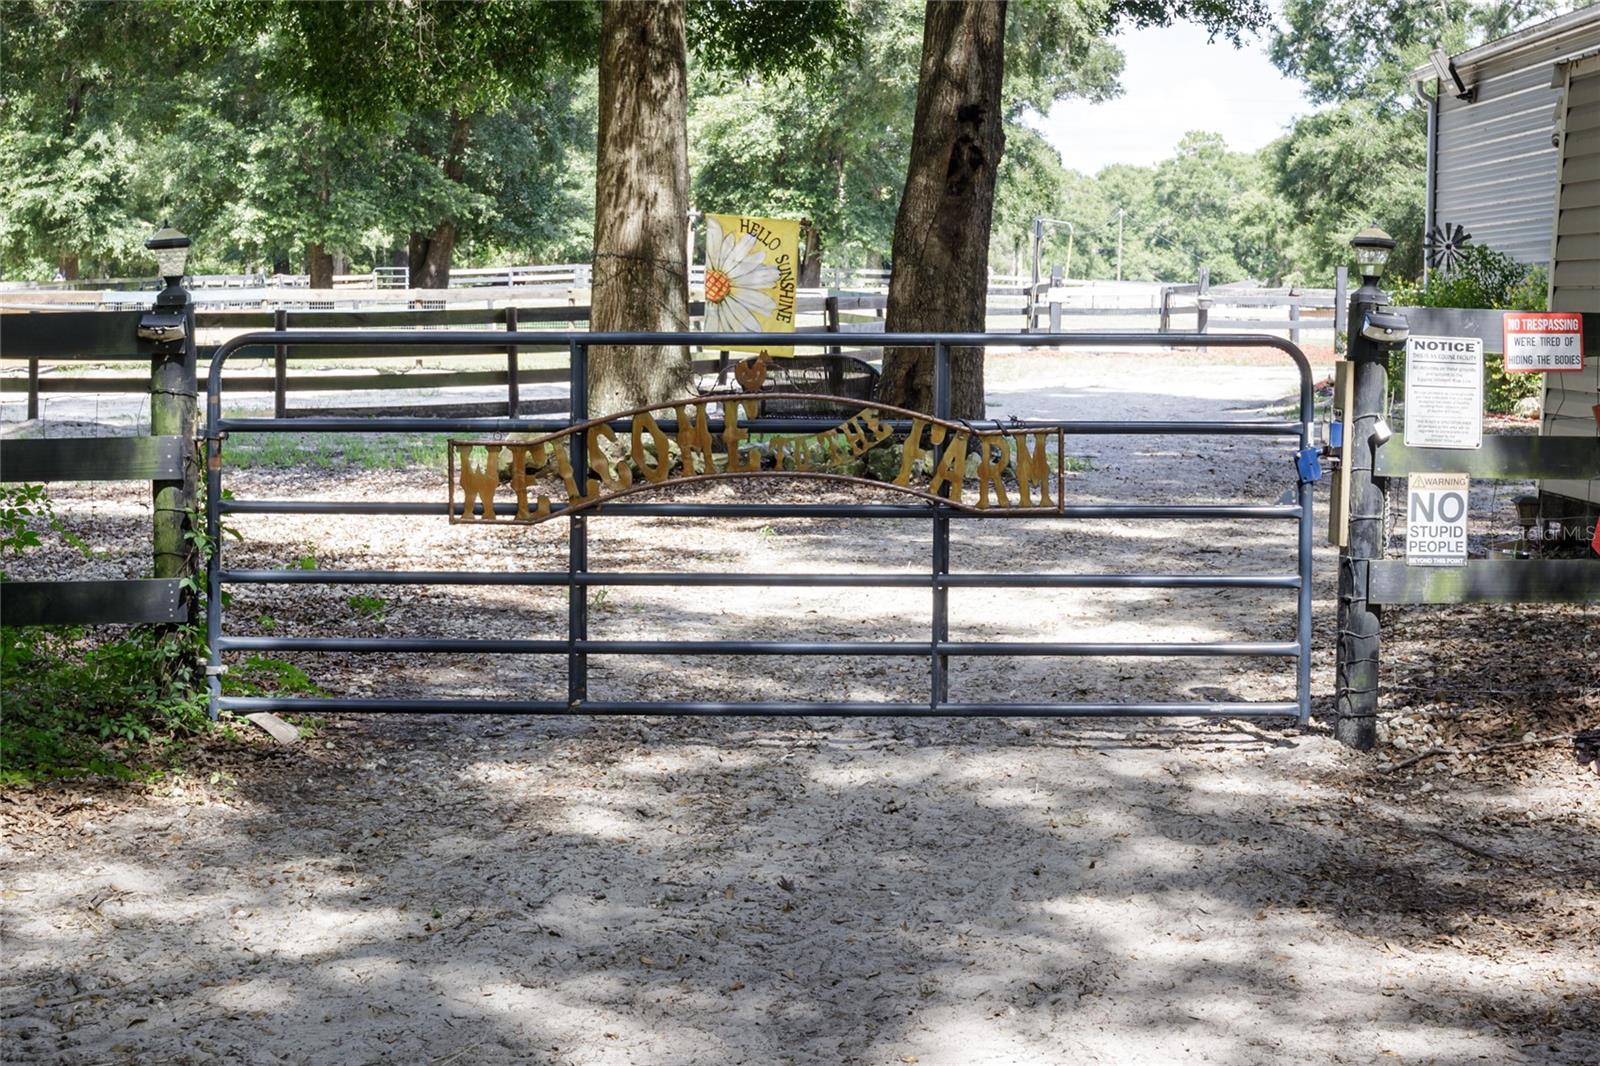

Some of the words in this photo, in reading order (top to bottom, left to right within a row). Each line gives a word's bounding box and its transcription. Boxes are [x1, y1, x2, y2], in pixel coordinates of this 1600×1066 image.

[740, 218, 781, 251] HELLO
[775, 253, 794, 324] SUNSHINE
[1507, 319, 1520, 330] NO
[1521, 319, 1579, 331] TRESPASSING
[1414, 341, 1475, 352] NOTICE
[1540, 337, 1560, 346] TIRED
[1564, 337, 1574, 346] OF
[1509, 355, 1533, 365] HIDING
[1537, 355, 1550, 365] THE
[1555, 355, 1580, 365] BODIES
[457, 400, 761, 520] WELCOME
[815, 408, 894, 466] THE
[892, 418, 1054, 509] FARM
[1424, 478, 1466, 486] WARNING
[1410, 492, 1465, 523] NO
[1410, 525, 1463, 538] STUPID
[1409, 541, 1464, 553] PEOPLE
